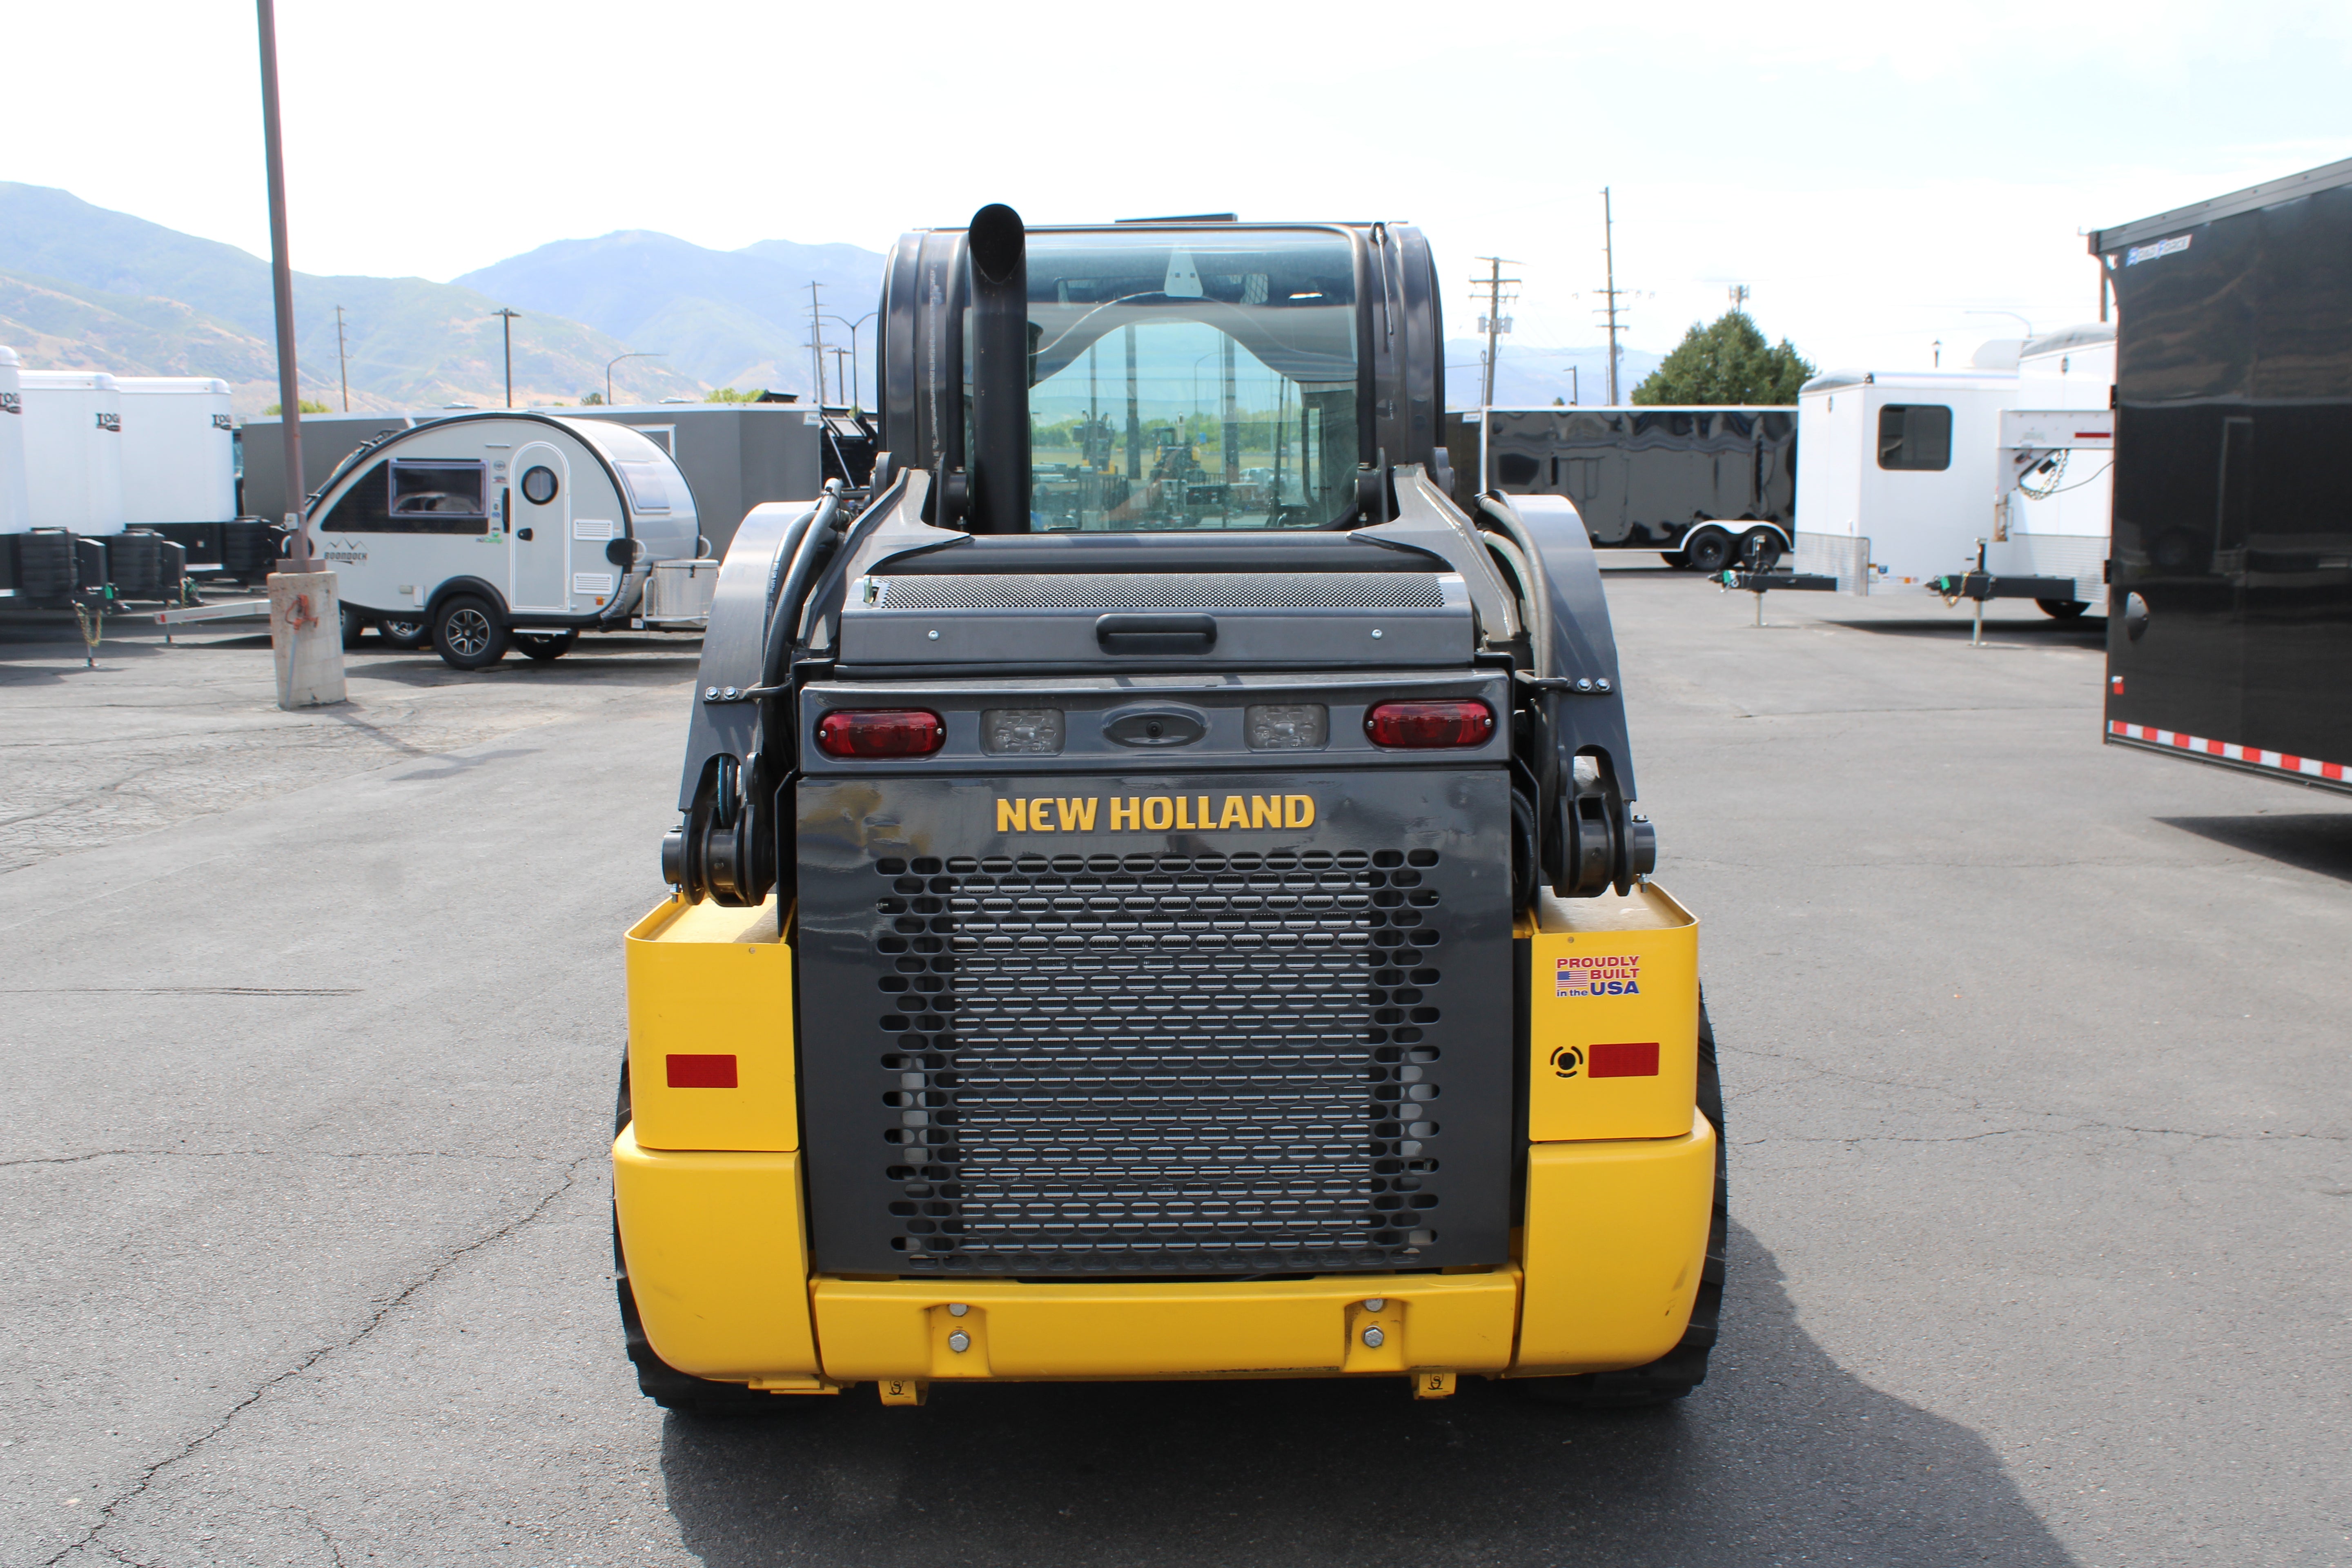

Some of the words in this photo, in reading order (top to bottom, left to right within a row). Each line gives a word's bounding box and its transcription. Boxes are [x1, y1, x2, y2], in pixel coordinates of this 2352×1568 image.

[997, 797, 1098, 832] NEW
[1110, 795, 1315, 831] HOLLAND
[1557, 956, 1639, 969] PROUDLY
[1590, 968, 1640, 980] BUILT
[1590, 981, 1639, 996] USA
